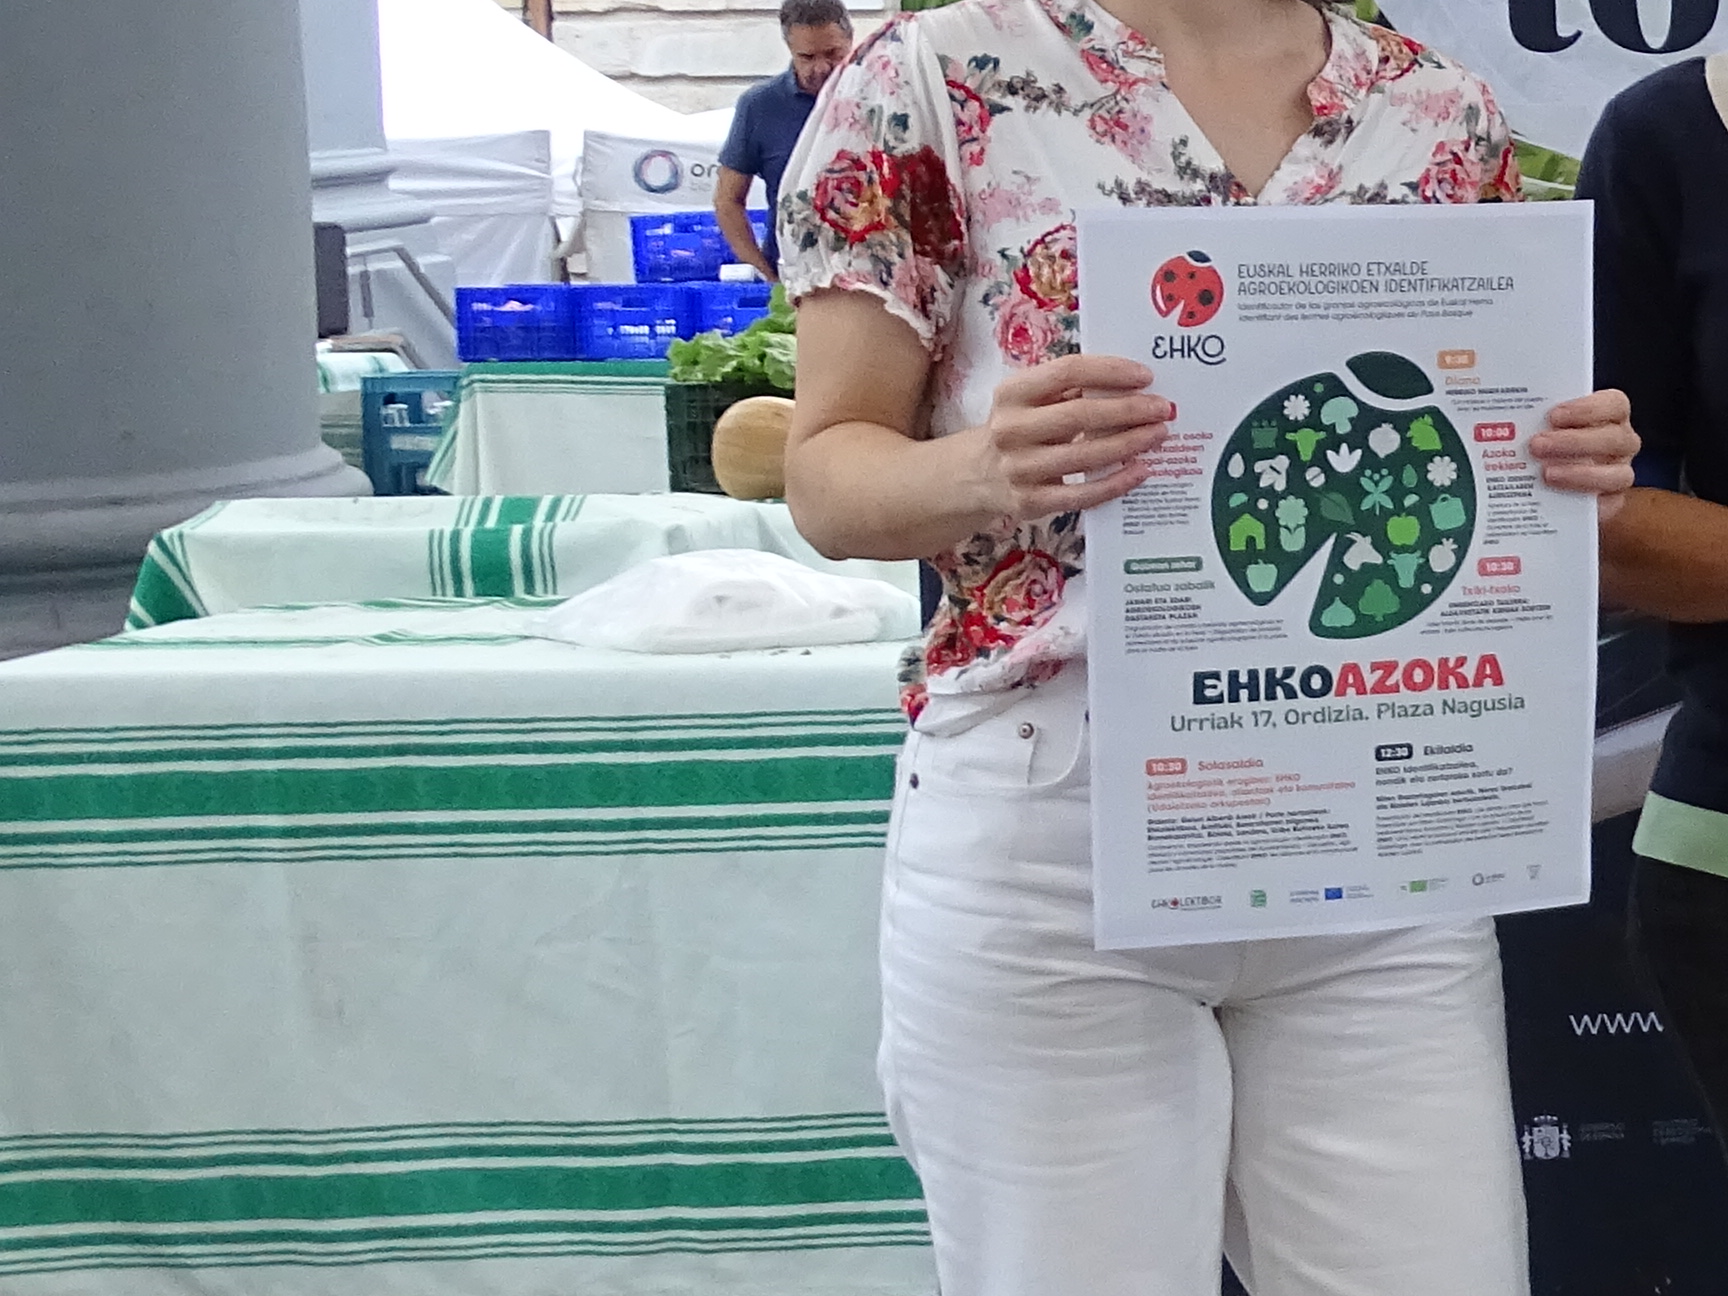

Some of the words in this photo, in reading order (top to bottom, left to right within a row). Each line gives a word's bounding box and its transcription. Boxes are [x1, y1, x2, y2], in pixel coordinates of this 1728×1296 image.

[1237, 262, 1293, 279] EUSKAL
[1299, 261, 1361, 278] HERRIKO
[1366, 260, 1429, 277] ETXALDE
[1237, 278, 1380, 296] AGROEKOLOGIKOEN
[1384, 276, 1514, 294] IDENTIFIKATZAILEA
[1151, 334, 1227, 366] EHKO
[1192, 653, 1505, 705] EHKOAZOKA
[1170, 713, 1243, 733] Urriak
[1376, 700, 1435, 720] Plaza
[1442, 692, 1525, 719] Nagusia
[1423, 743, 1474, 755] Ekitaldia
[1198, 758, 1264, 772] Solasaldia
